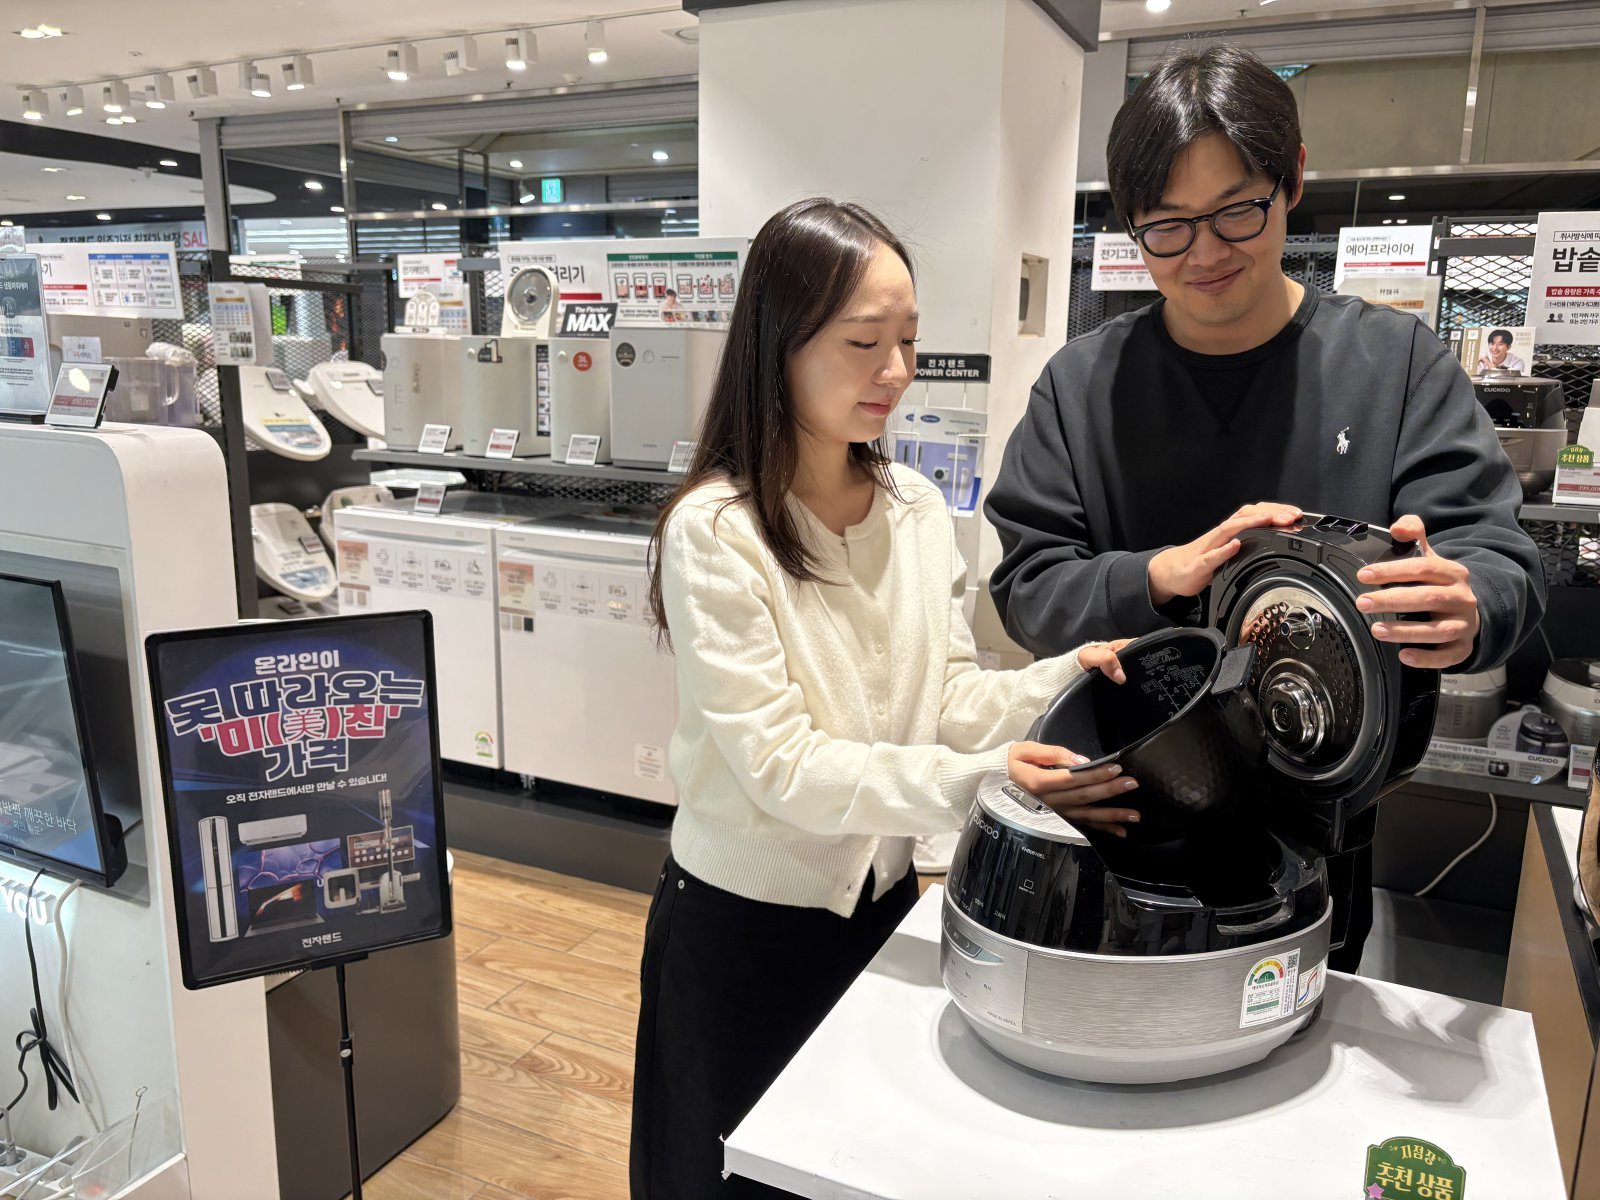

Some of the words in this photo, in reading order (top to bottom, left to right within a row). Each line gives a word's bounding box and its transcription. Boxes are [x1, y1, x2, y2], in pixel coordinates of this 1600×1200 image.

[1101, 248, 1138, 260] 전기그릴
[1345, 242, 1414, 256] 에어프라이어
[1552, 247, 1600, 273] 밥솥
[41, 261, 52, 277] 기
[566, 314, 613, 332] MAX
[915, 368, 944, 376] POWER
[945, 369, 980, 377] CENTER
[254, 650, 340, 675] 온라인이
[164, 688, 223, 736] 못
[230, 671, 425, 719] 따라오는
[263, 737, 350, 783] 가격
[1527, 755, 1559, 765] CUCKOO
[225, 792, 246, 805] 오직
[247, 784, 315, 803] 전자랜드에서만
[316, 781, 335, 794] 만날
[337, 779, 347, 790] 수
[347, 773, 388, 789] 있습니다!
[23, 807, 54, 828] 깨끗한
[56, 816, 77, 835] 바닥
[973, 813, 999, 840] CUCKOO
[301, 932, 343, 949] 전자랜드
[1400, 1144, 1437, 1166] 지점장
[1375, 1161, 1413, 1192] 추천
[1416, 1172, 1454, 1200] 상품
